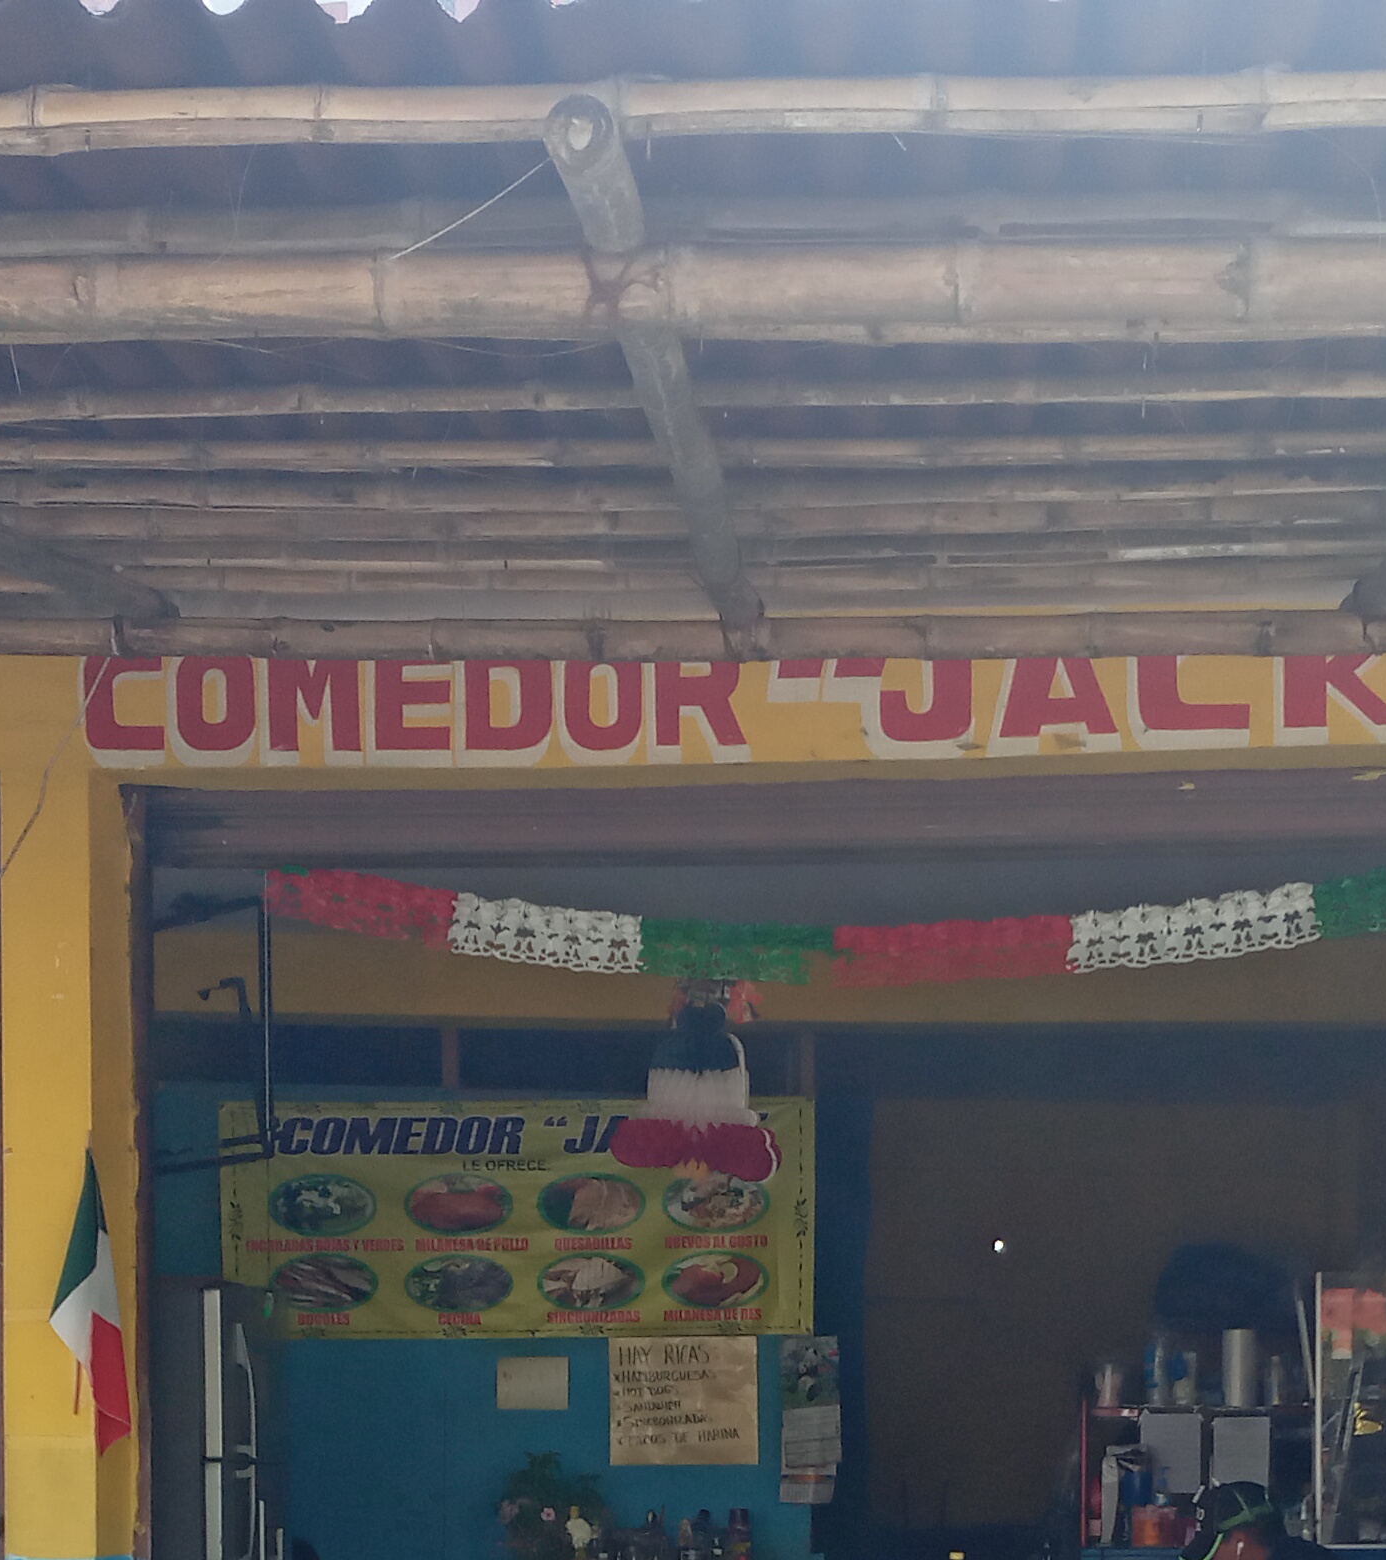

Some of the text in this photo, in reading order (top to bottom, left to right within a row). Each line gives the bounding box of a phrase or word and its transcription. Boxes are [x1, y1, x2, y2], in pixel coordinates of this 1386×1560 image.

[83, 656, 751, 764] COMEDOR
[279, 1116, 527, 1155] COMEDOR
[463, 1160, 481, 1171] LE
[554, 1237, 632, 1251] QUESADILLAS
[618, 1344, 710, 1366] HAY RICAS
